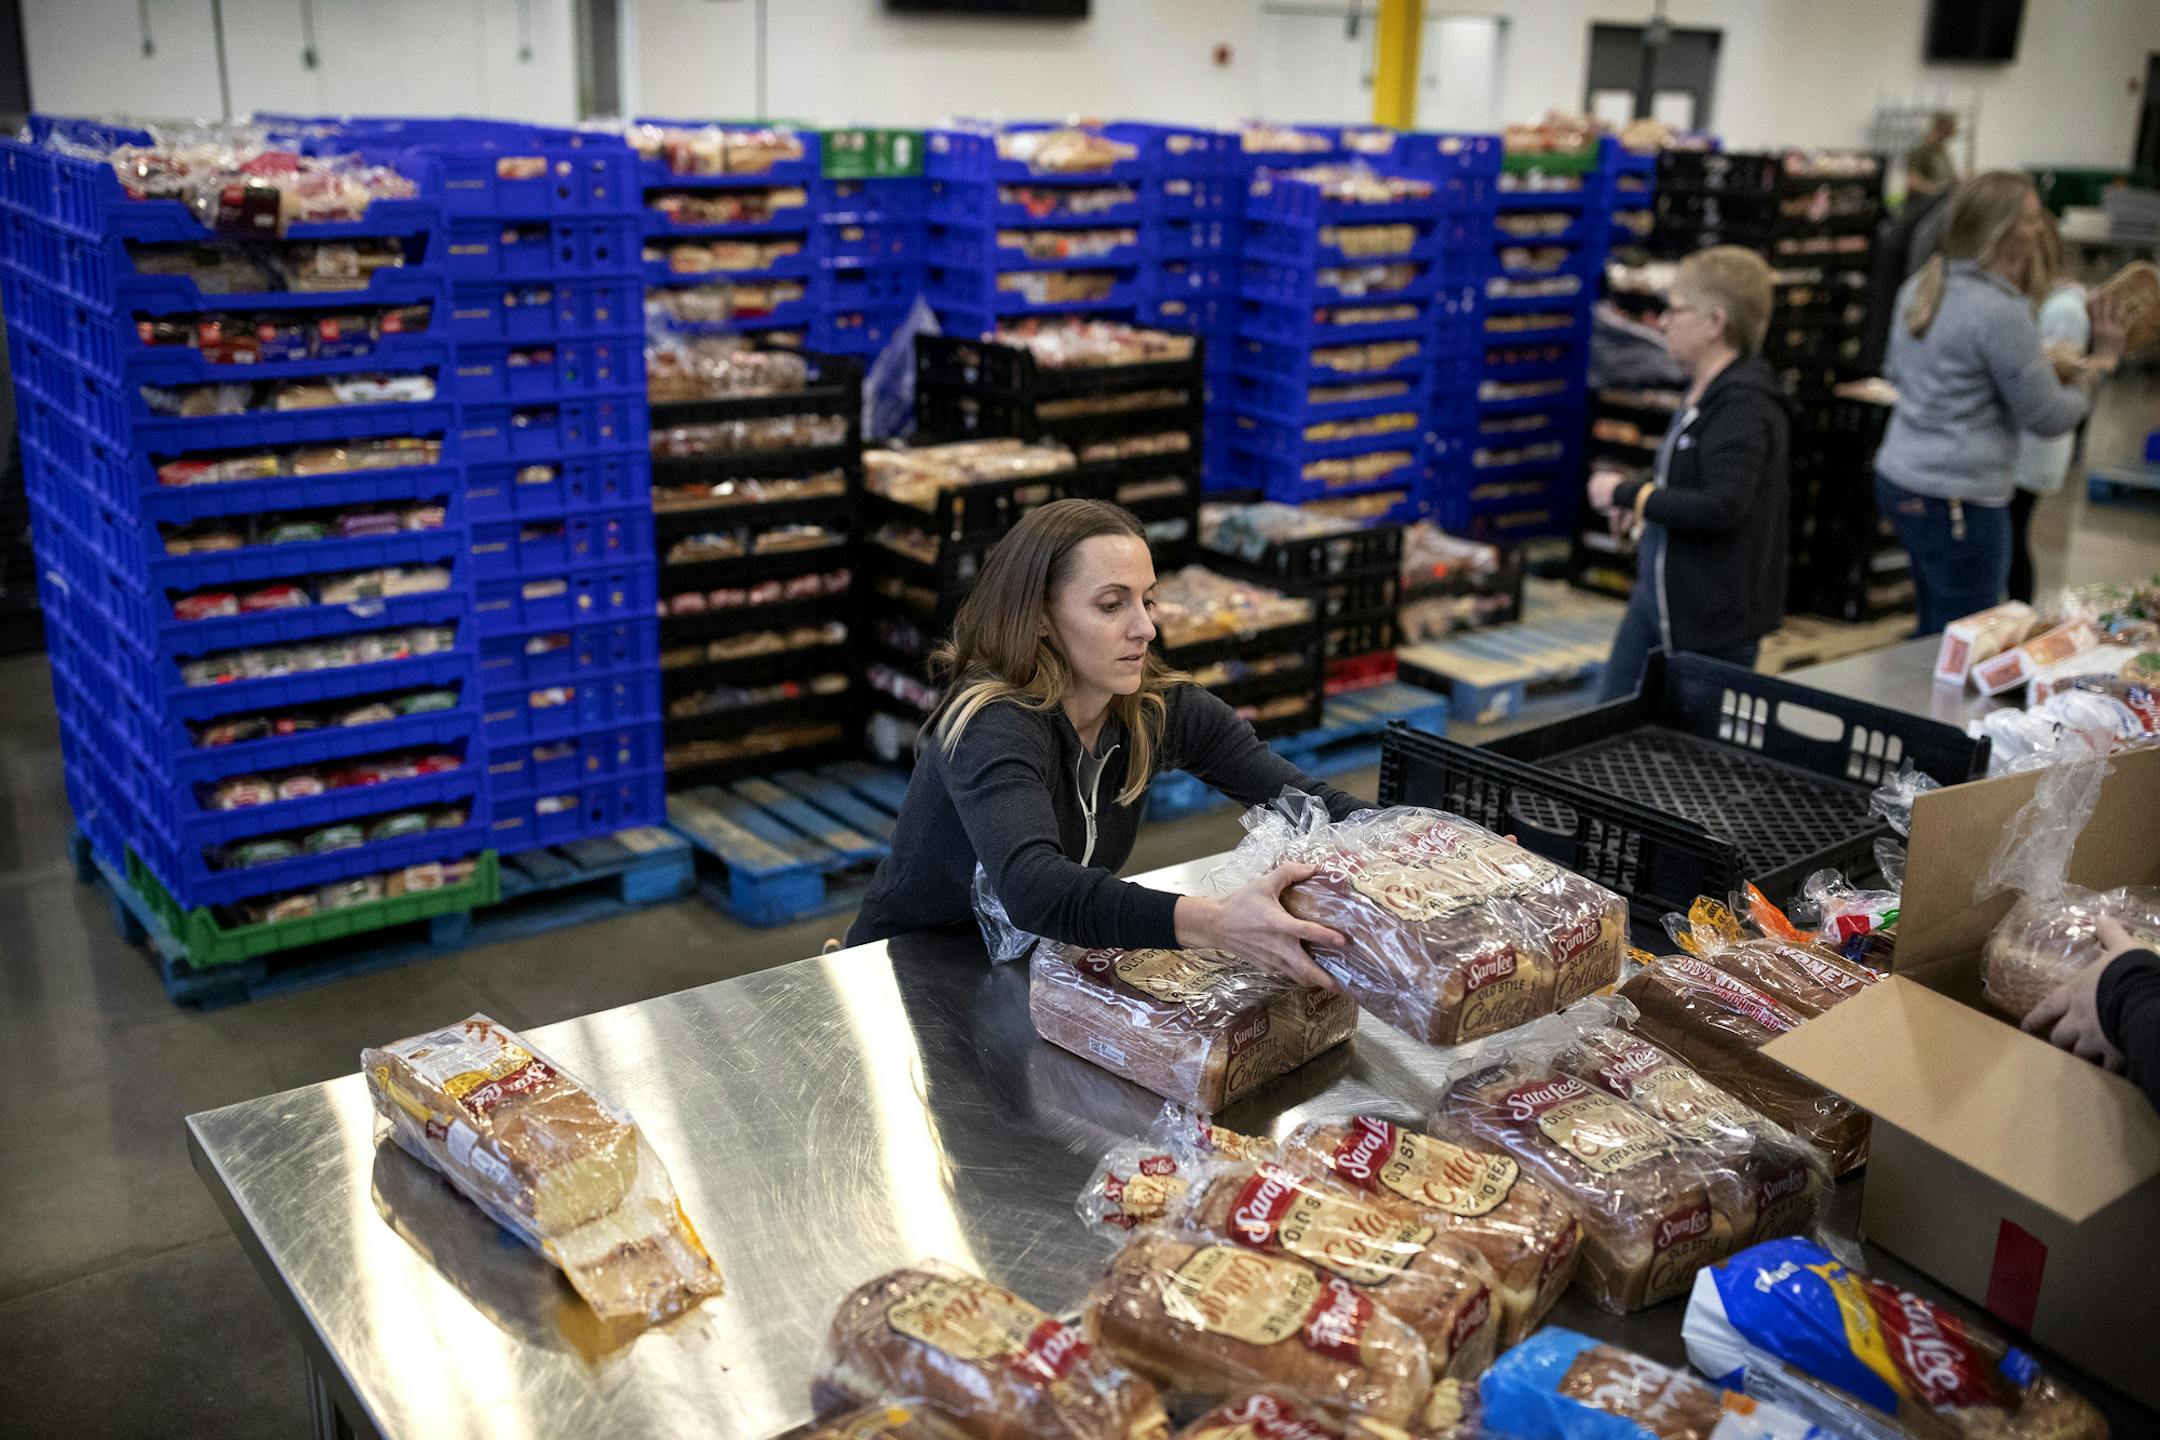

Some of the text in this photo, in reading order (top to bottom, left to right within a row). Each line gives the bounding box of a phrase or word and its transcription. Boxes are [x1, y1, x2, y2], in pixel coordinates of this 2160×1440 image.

[1119, 955, 1145, 973] OLD
[1569, 940, 1609, 971] OLD STYLE
[1468, 953, 1517, 990] Sara Lee
[1478, 979, 1527, 1001] OLD STYLE
[1748, 1003, 1781, 1032] BREAD
[1256, 1036, 1278, 1054] STYLE
[1507, 1077, 1587, 1121] Sara Lee
[1543, 1108, 1571, 1127] OLD
[1338, 1129, 1379, 1179] Sara
[1235, 1175, 1284, 1243] Sara
[1657, 1211, 1711, 1248] Sara Lee
